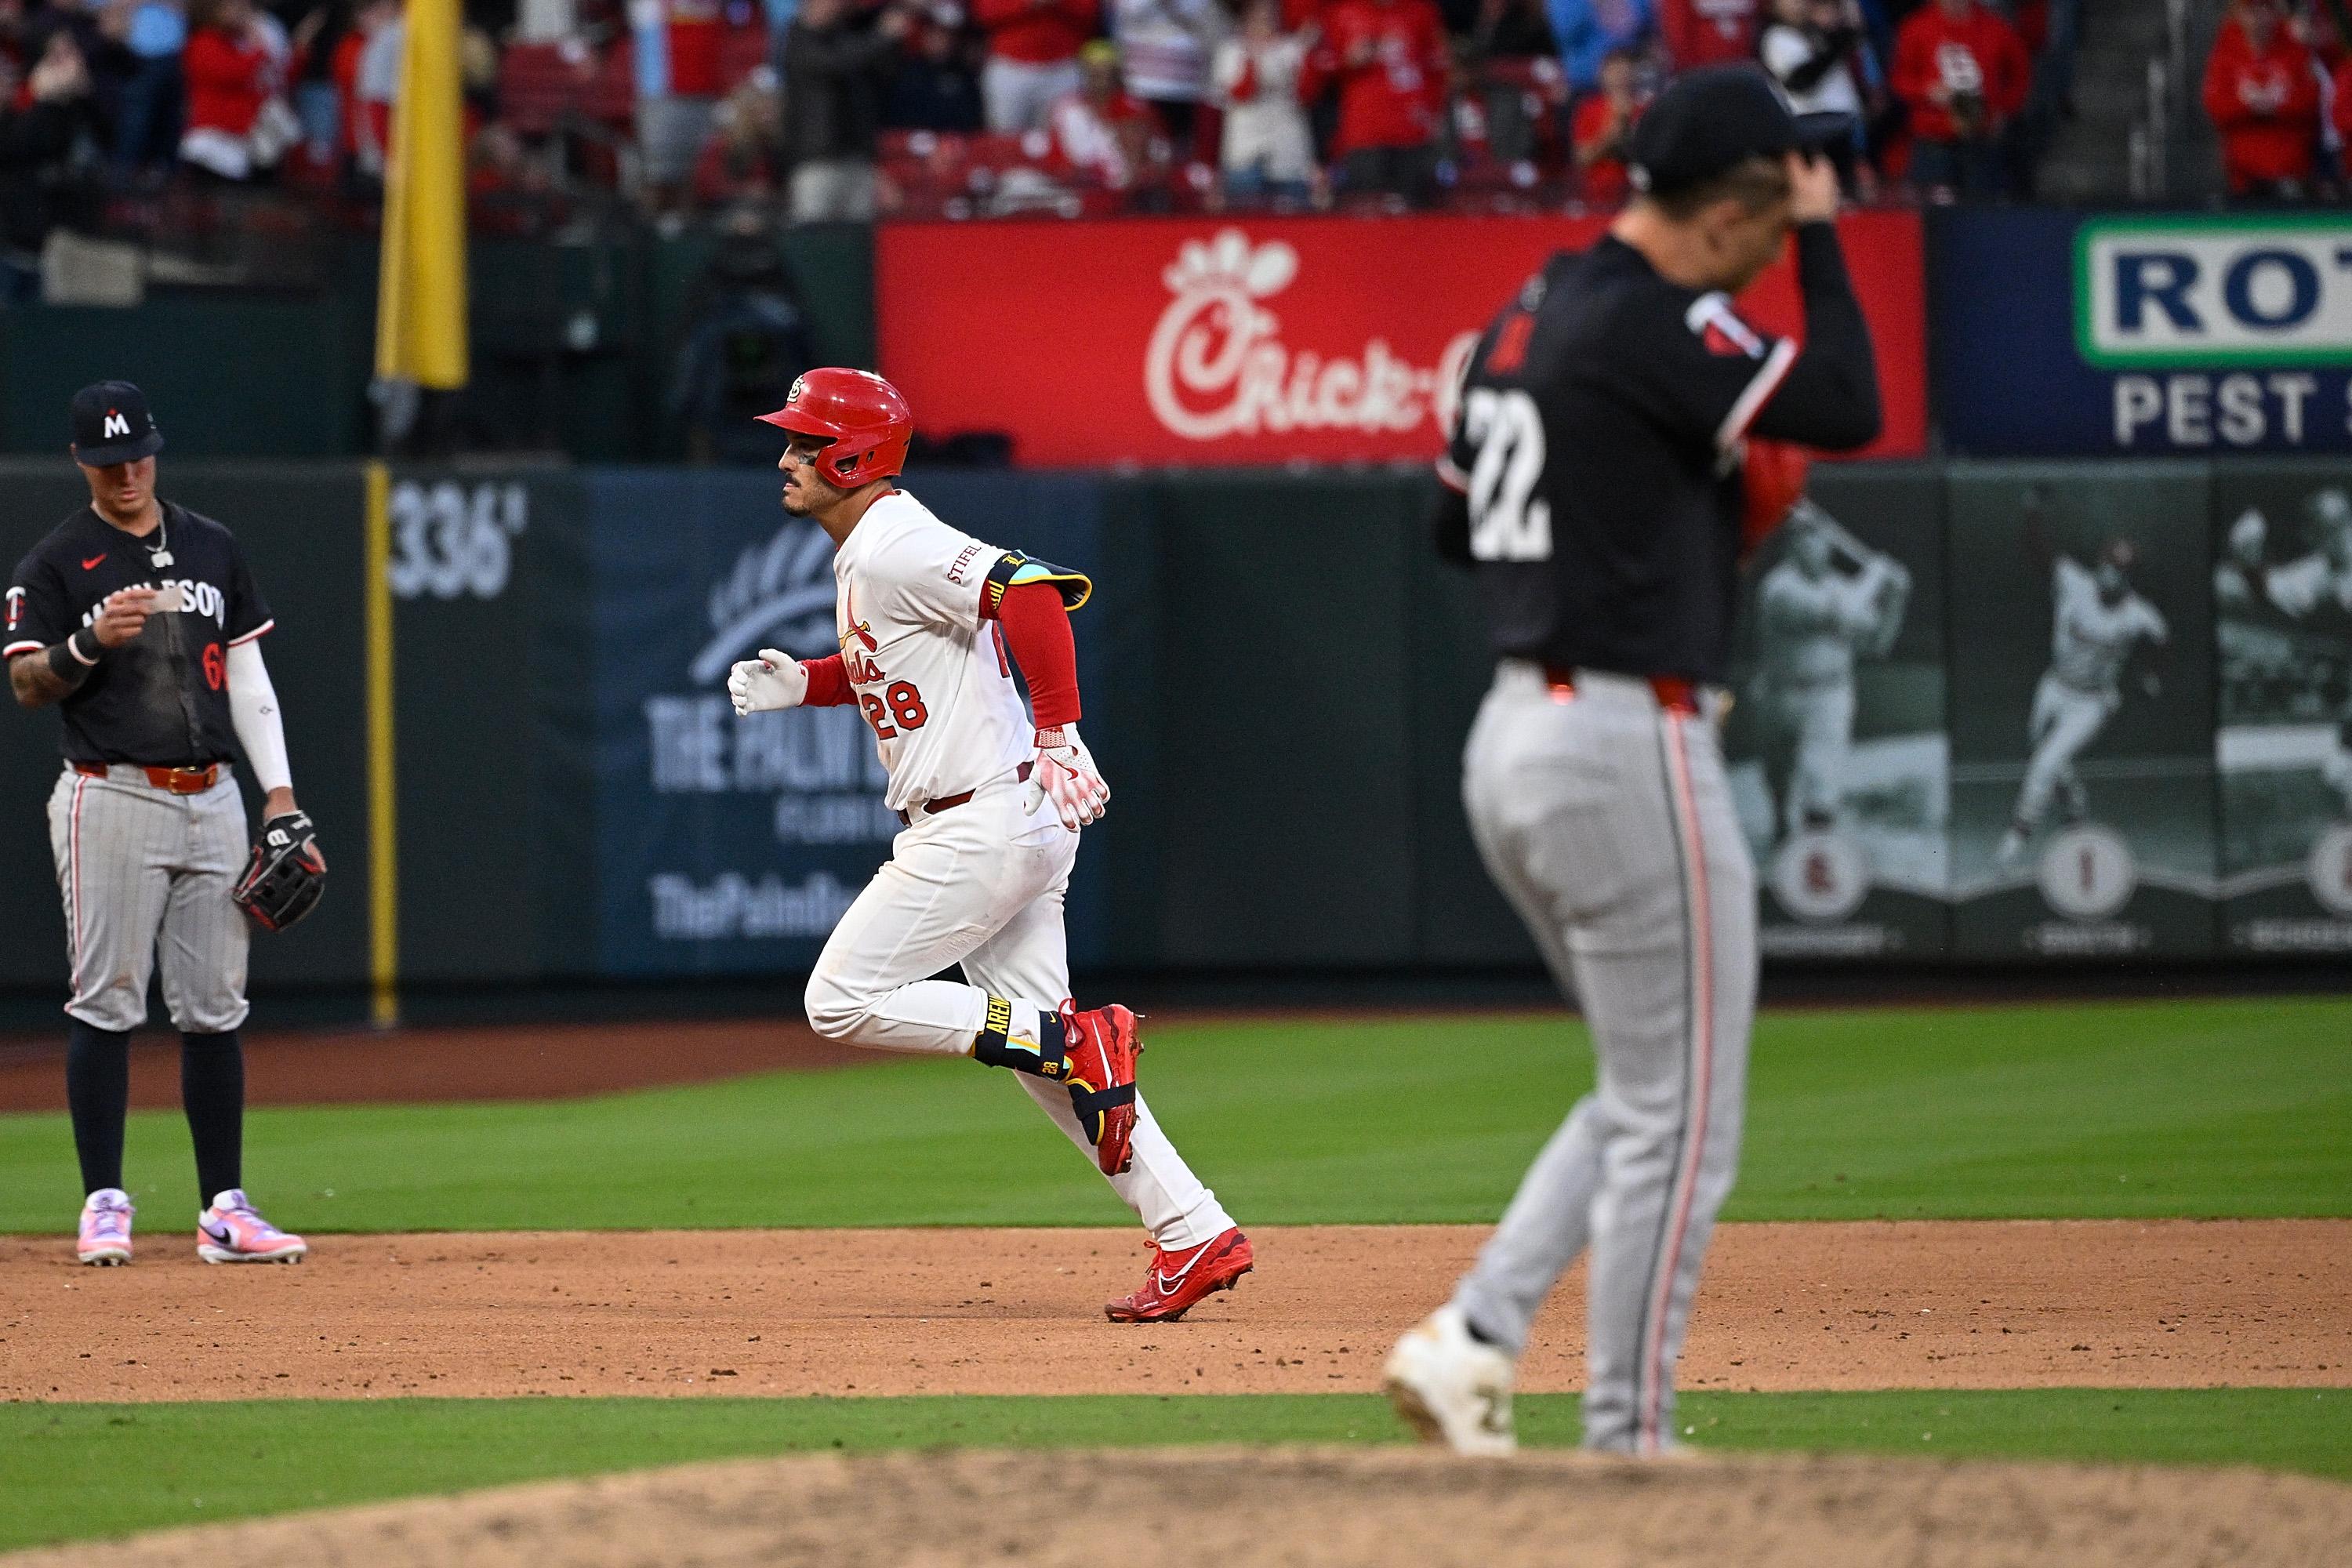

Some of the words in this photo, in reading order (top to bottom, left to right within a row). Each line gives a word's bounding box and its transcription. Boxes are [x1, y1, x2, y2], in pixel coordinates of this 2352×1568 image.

[2114, 249, 2352, 335] RO
[104, 413, 131, 438] M
[2114, 372, 2318, 446] PEST
[1465, 387, 1554, 561] 22
[947, 545, 982, 585] STIFEL
[202, 642, 230, 691] 6
[861, 679, 929, 741] 28
